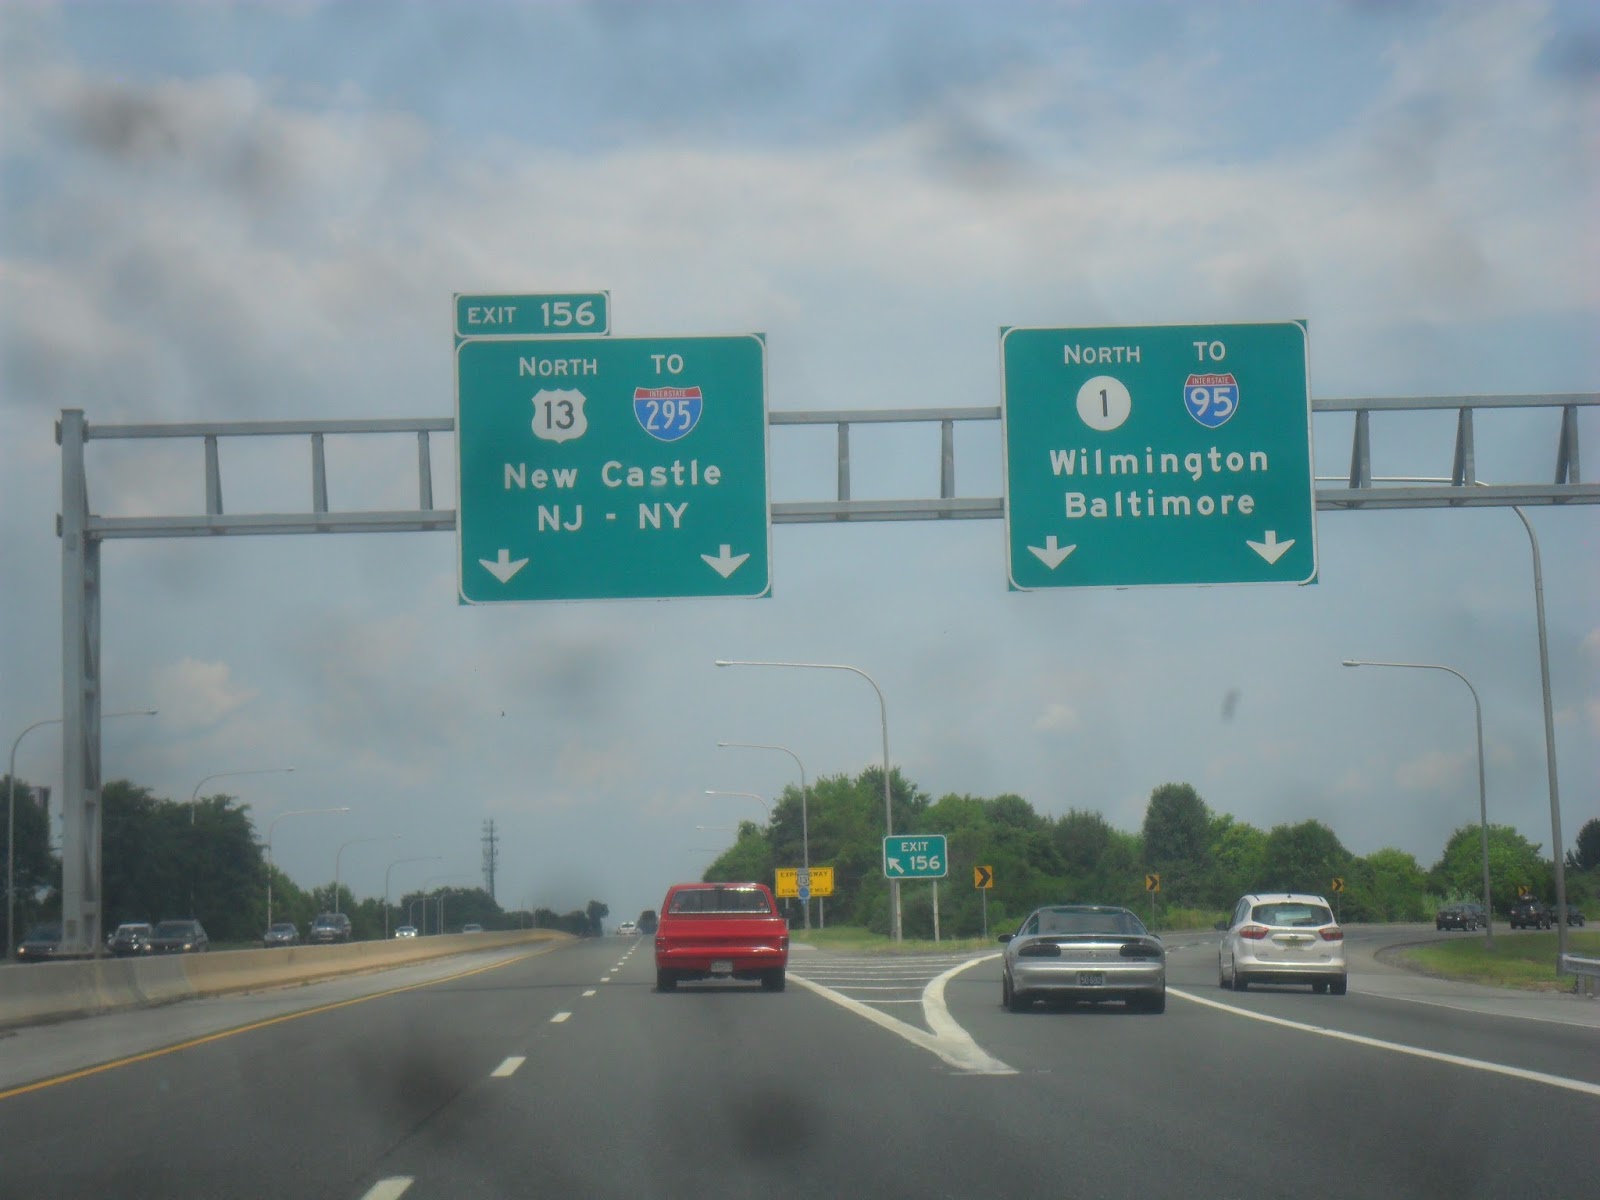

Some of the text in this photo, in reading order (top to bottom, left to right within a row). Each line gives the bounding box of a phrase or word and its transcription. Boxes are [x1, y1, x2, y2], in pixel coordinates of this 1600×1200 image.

[467, 300, 596, 327] EXIT 156
[650, 353, 684, 375] TO
[1063, 344, 1141, 365] NORTH
[1192, 340, 1226, 362] TO
[519, 356, 598, 377] NORTH
[649, 389, 687, 398] INTERSTATE
[1192, 376, 1230, 385] INTERSTATE
[544, 400, 575, 430] 13
[646, 400, 691, 430] 295
[1099, 389, 1109, 418] 1
[1190, 387, 1233, 417] 95
[504, 459, 723, 490] New Castle
[1049, 446, 1269, 482] Wilmington
[537, 504, 583, 532] NJ
[639, 502, 690, 530] NY
[1065, 488, 1256, 519] Baltimore
[901, 841, 929, 853] EXIT
[909, 854, 941, 871] 156
